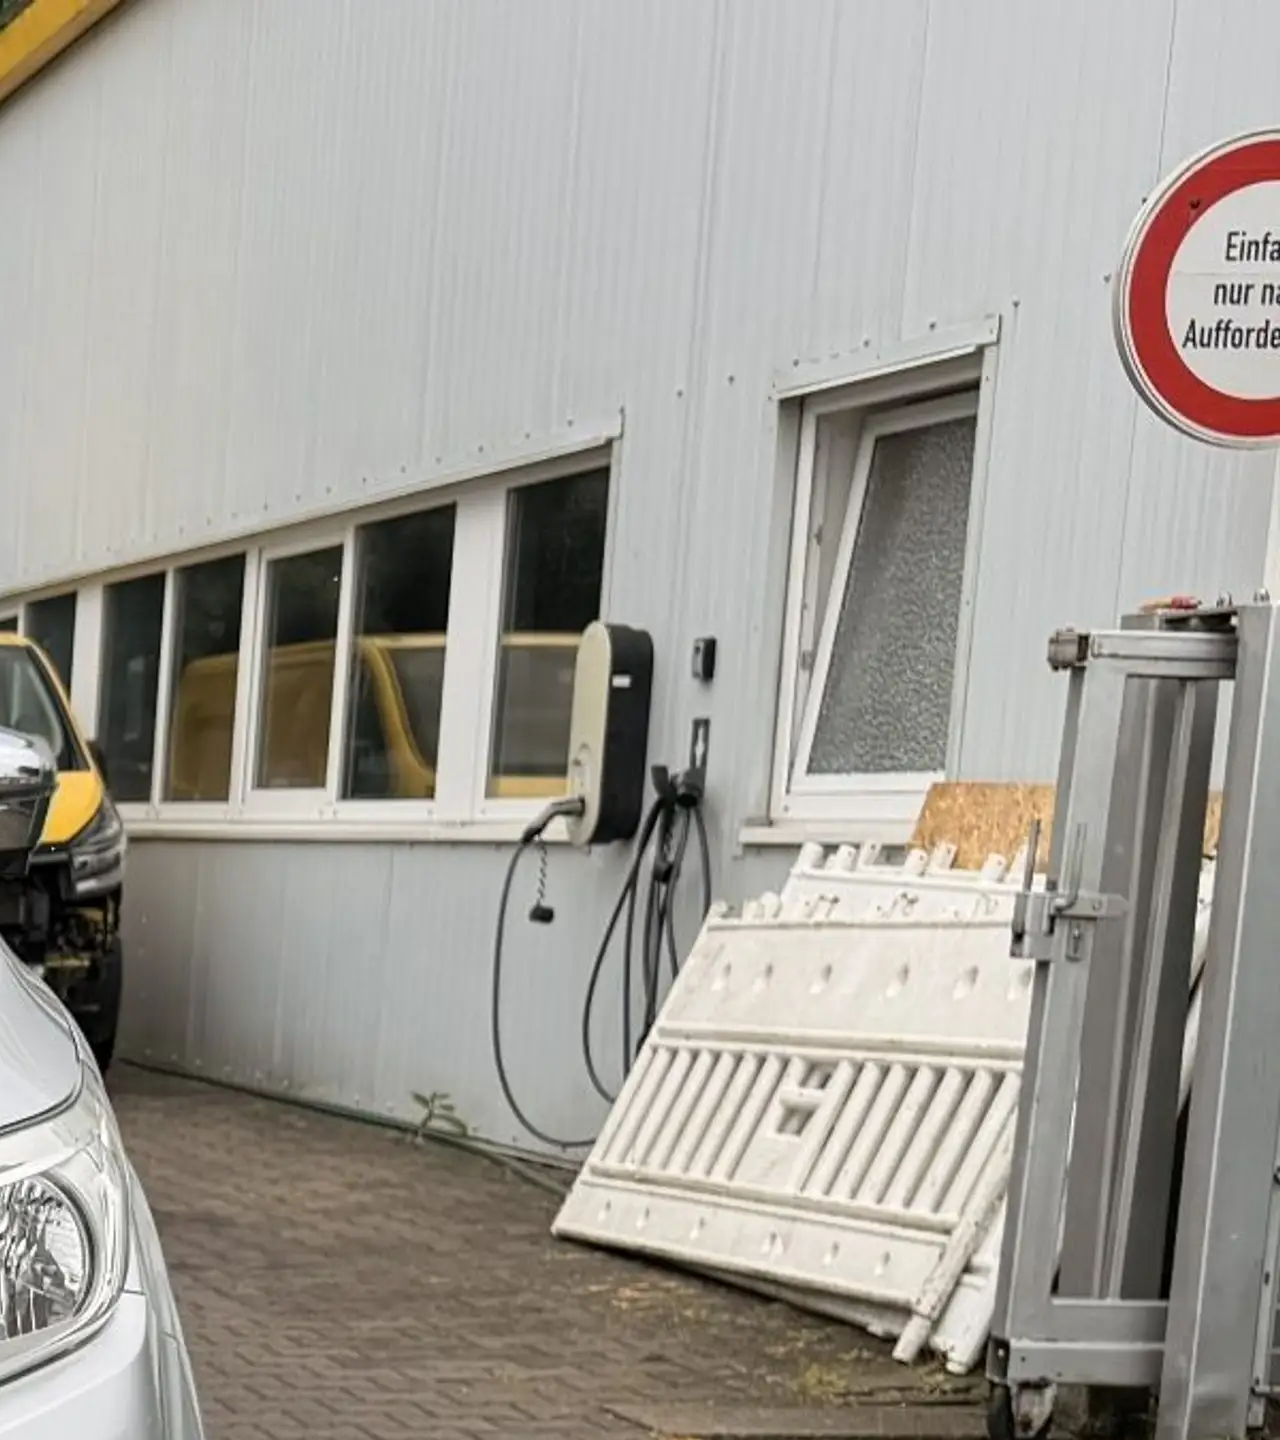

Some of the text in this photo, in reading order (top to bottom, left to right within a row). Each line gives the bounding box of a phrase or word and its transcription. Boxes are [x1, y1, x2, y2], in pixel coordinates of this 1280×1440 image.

[1224, 230, 1280, 262] Einfa
[1213, 283, 1255, 306] nur
[1182, 318, 1280, 349] Aufforde
